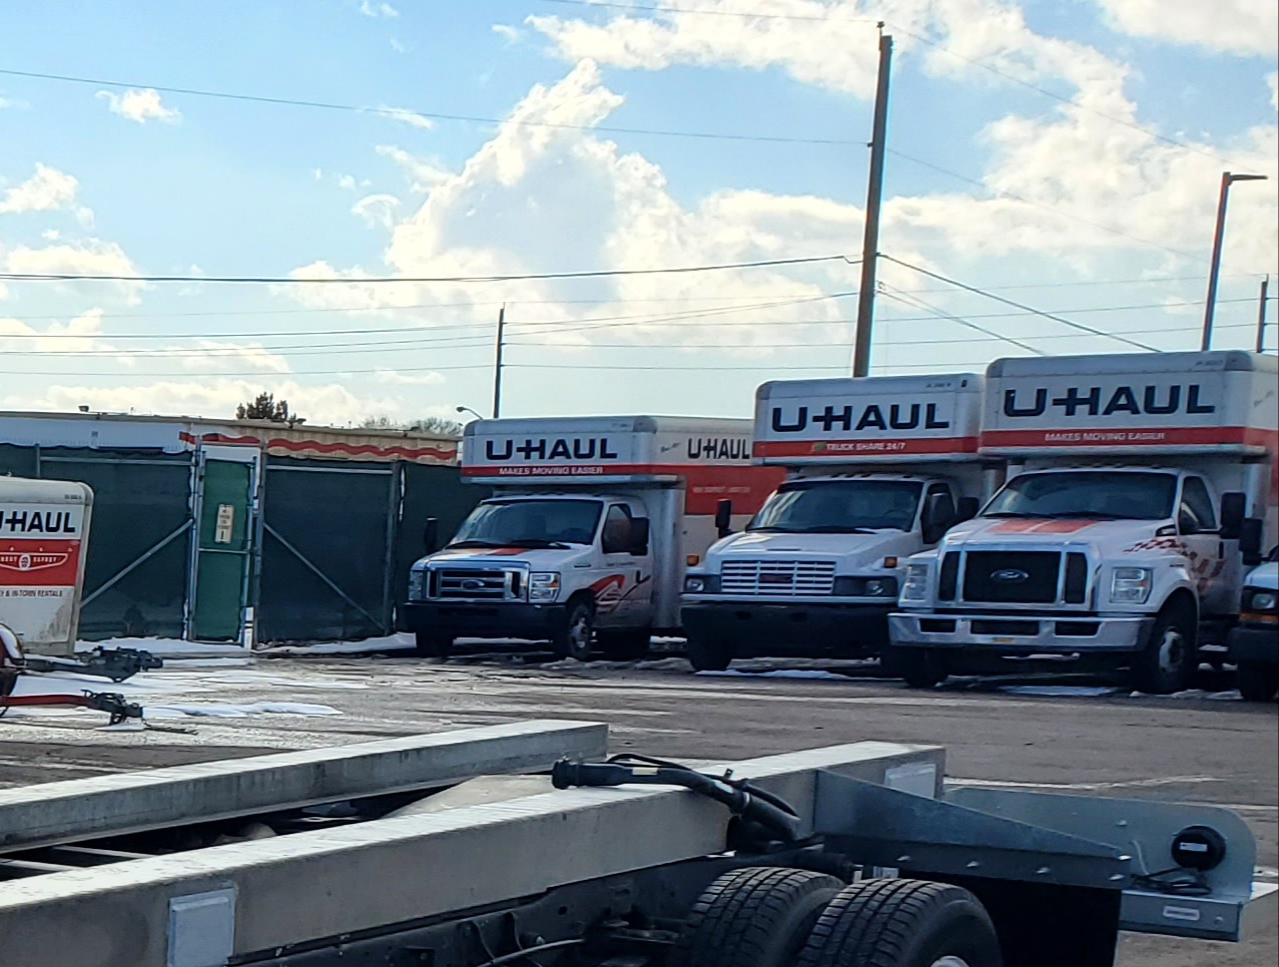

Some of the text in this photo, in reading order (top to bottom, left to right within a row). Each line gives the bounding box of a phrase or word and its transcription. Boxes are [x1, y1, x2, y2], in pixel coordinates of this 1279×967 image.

[1003, 384, 1215, 417] U-HAUL
[772, 403, 950, 432] U-HAUL
[826, 443, 854, 451] TRUCK
[856, 443, 884, 451] SHARE
[1045, 432, 1166, 441] MAKES MOVING EASIER
[486, 438, 618, 460] U-HAUL
[688, 438, 750, 459] U-HAUL
[499, 467, 530, 475] MAKES
[532, 467, 570, 475] MOVING
